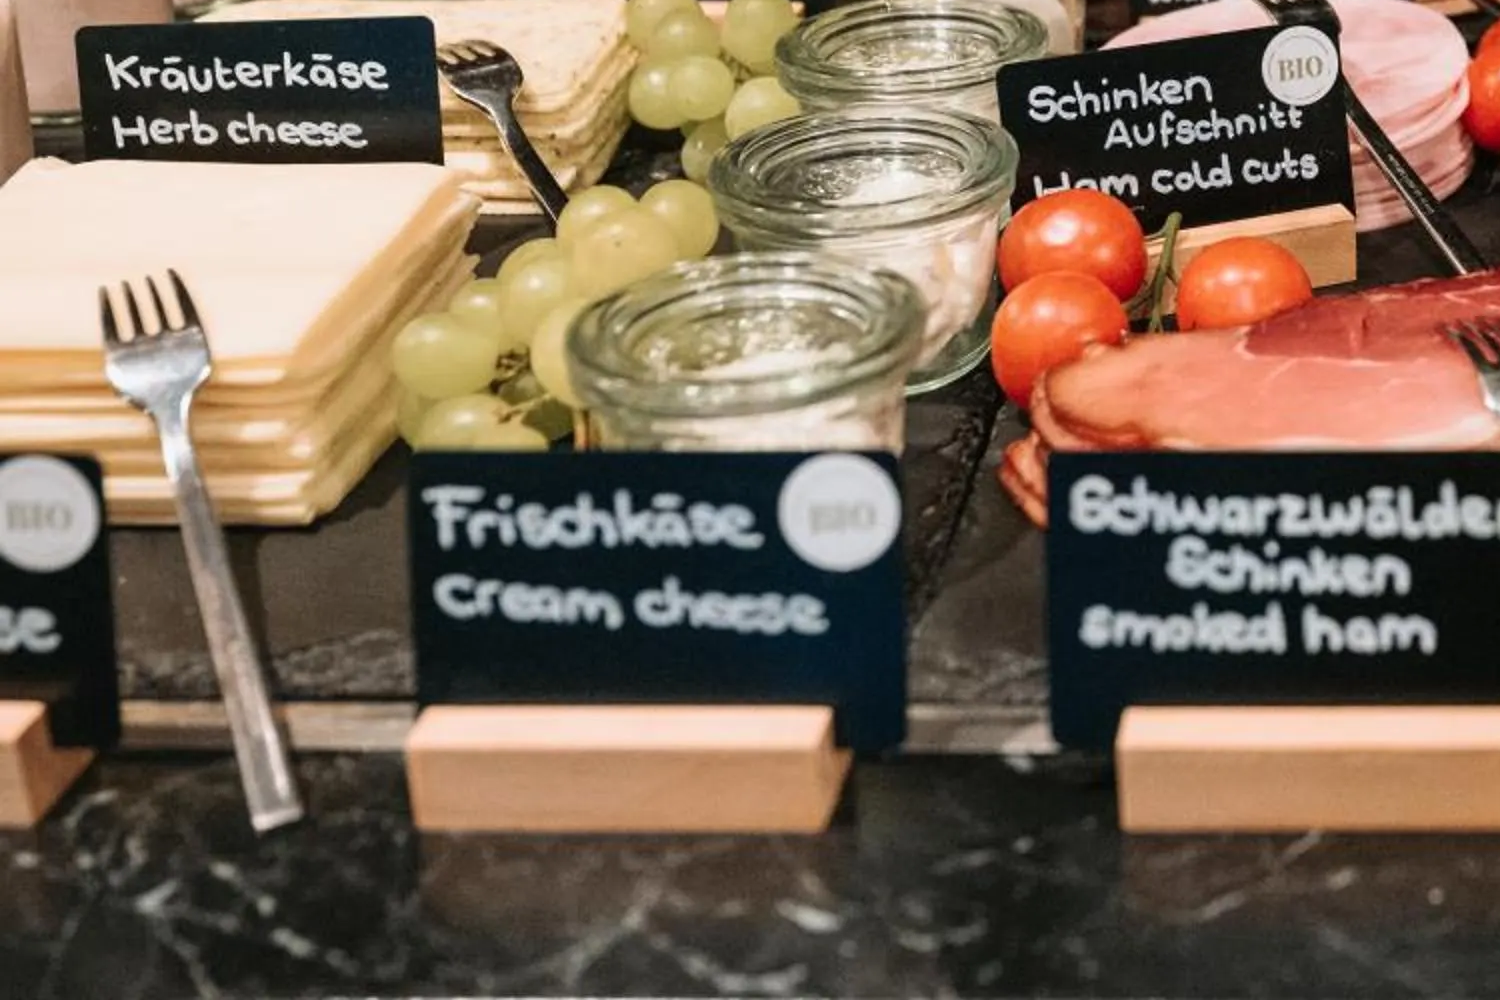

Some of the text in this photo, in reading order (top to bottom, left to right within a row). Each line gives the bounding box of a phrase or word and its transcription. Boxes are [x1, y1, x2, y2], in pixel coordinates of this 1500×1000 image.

[105, 50, 390, 94] Kräuterkäse
[1277, 55, 1324, 83] BIO
[1028, 73, 1213, 123] Schinken
[112, 111, 368, 149] Herb cheese
[1104, 102, 1303, 150] Aufschnitt
[1151, 153, 1233, 194] cold
[1241, 148, 1320, 184] cuts
[420, 484, 765, 549] Frischkäse
[1166, 535, 1412, 597] Schinken
[634, 576, 830, 635] cheese
[1303, 603, 1438, 655] ham
